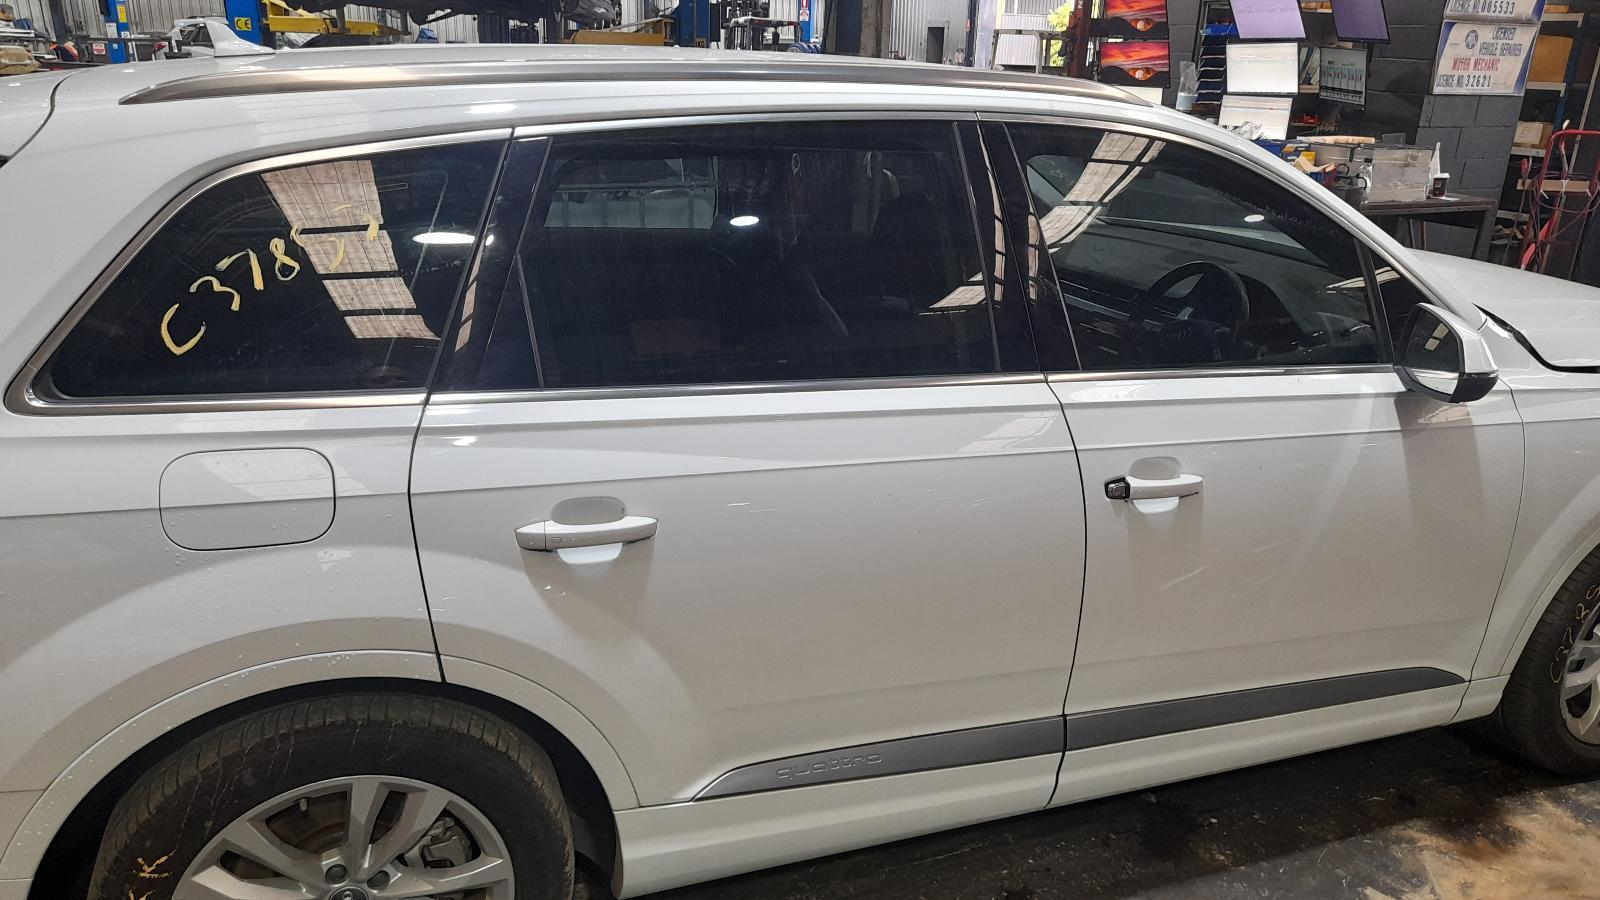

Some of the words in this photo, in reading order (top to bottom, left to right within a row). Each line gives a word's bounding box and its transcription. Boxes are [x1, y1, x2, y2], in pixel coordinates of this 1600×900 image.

[1492, 26, 1517, 41] LICENSED
[1479, 41, 1499, 56] VEHICLE
[1499, 42, 1523, 57] REPAIRER
[1451, 57, 1471, 72] MOTOR
[1472, 57, 1501, 72] MECHANIC
[1464, 74, 1492, 88] 32621
[776, 754, 882, 781] quattro
